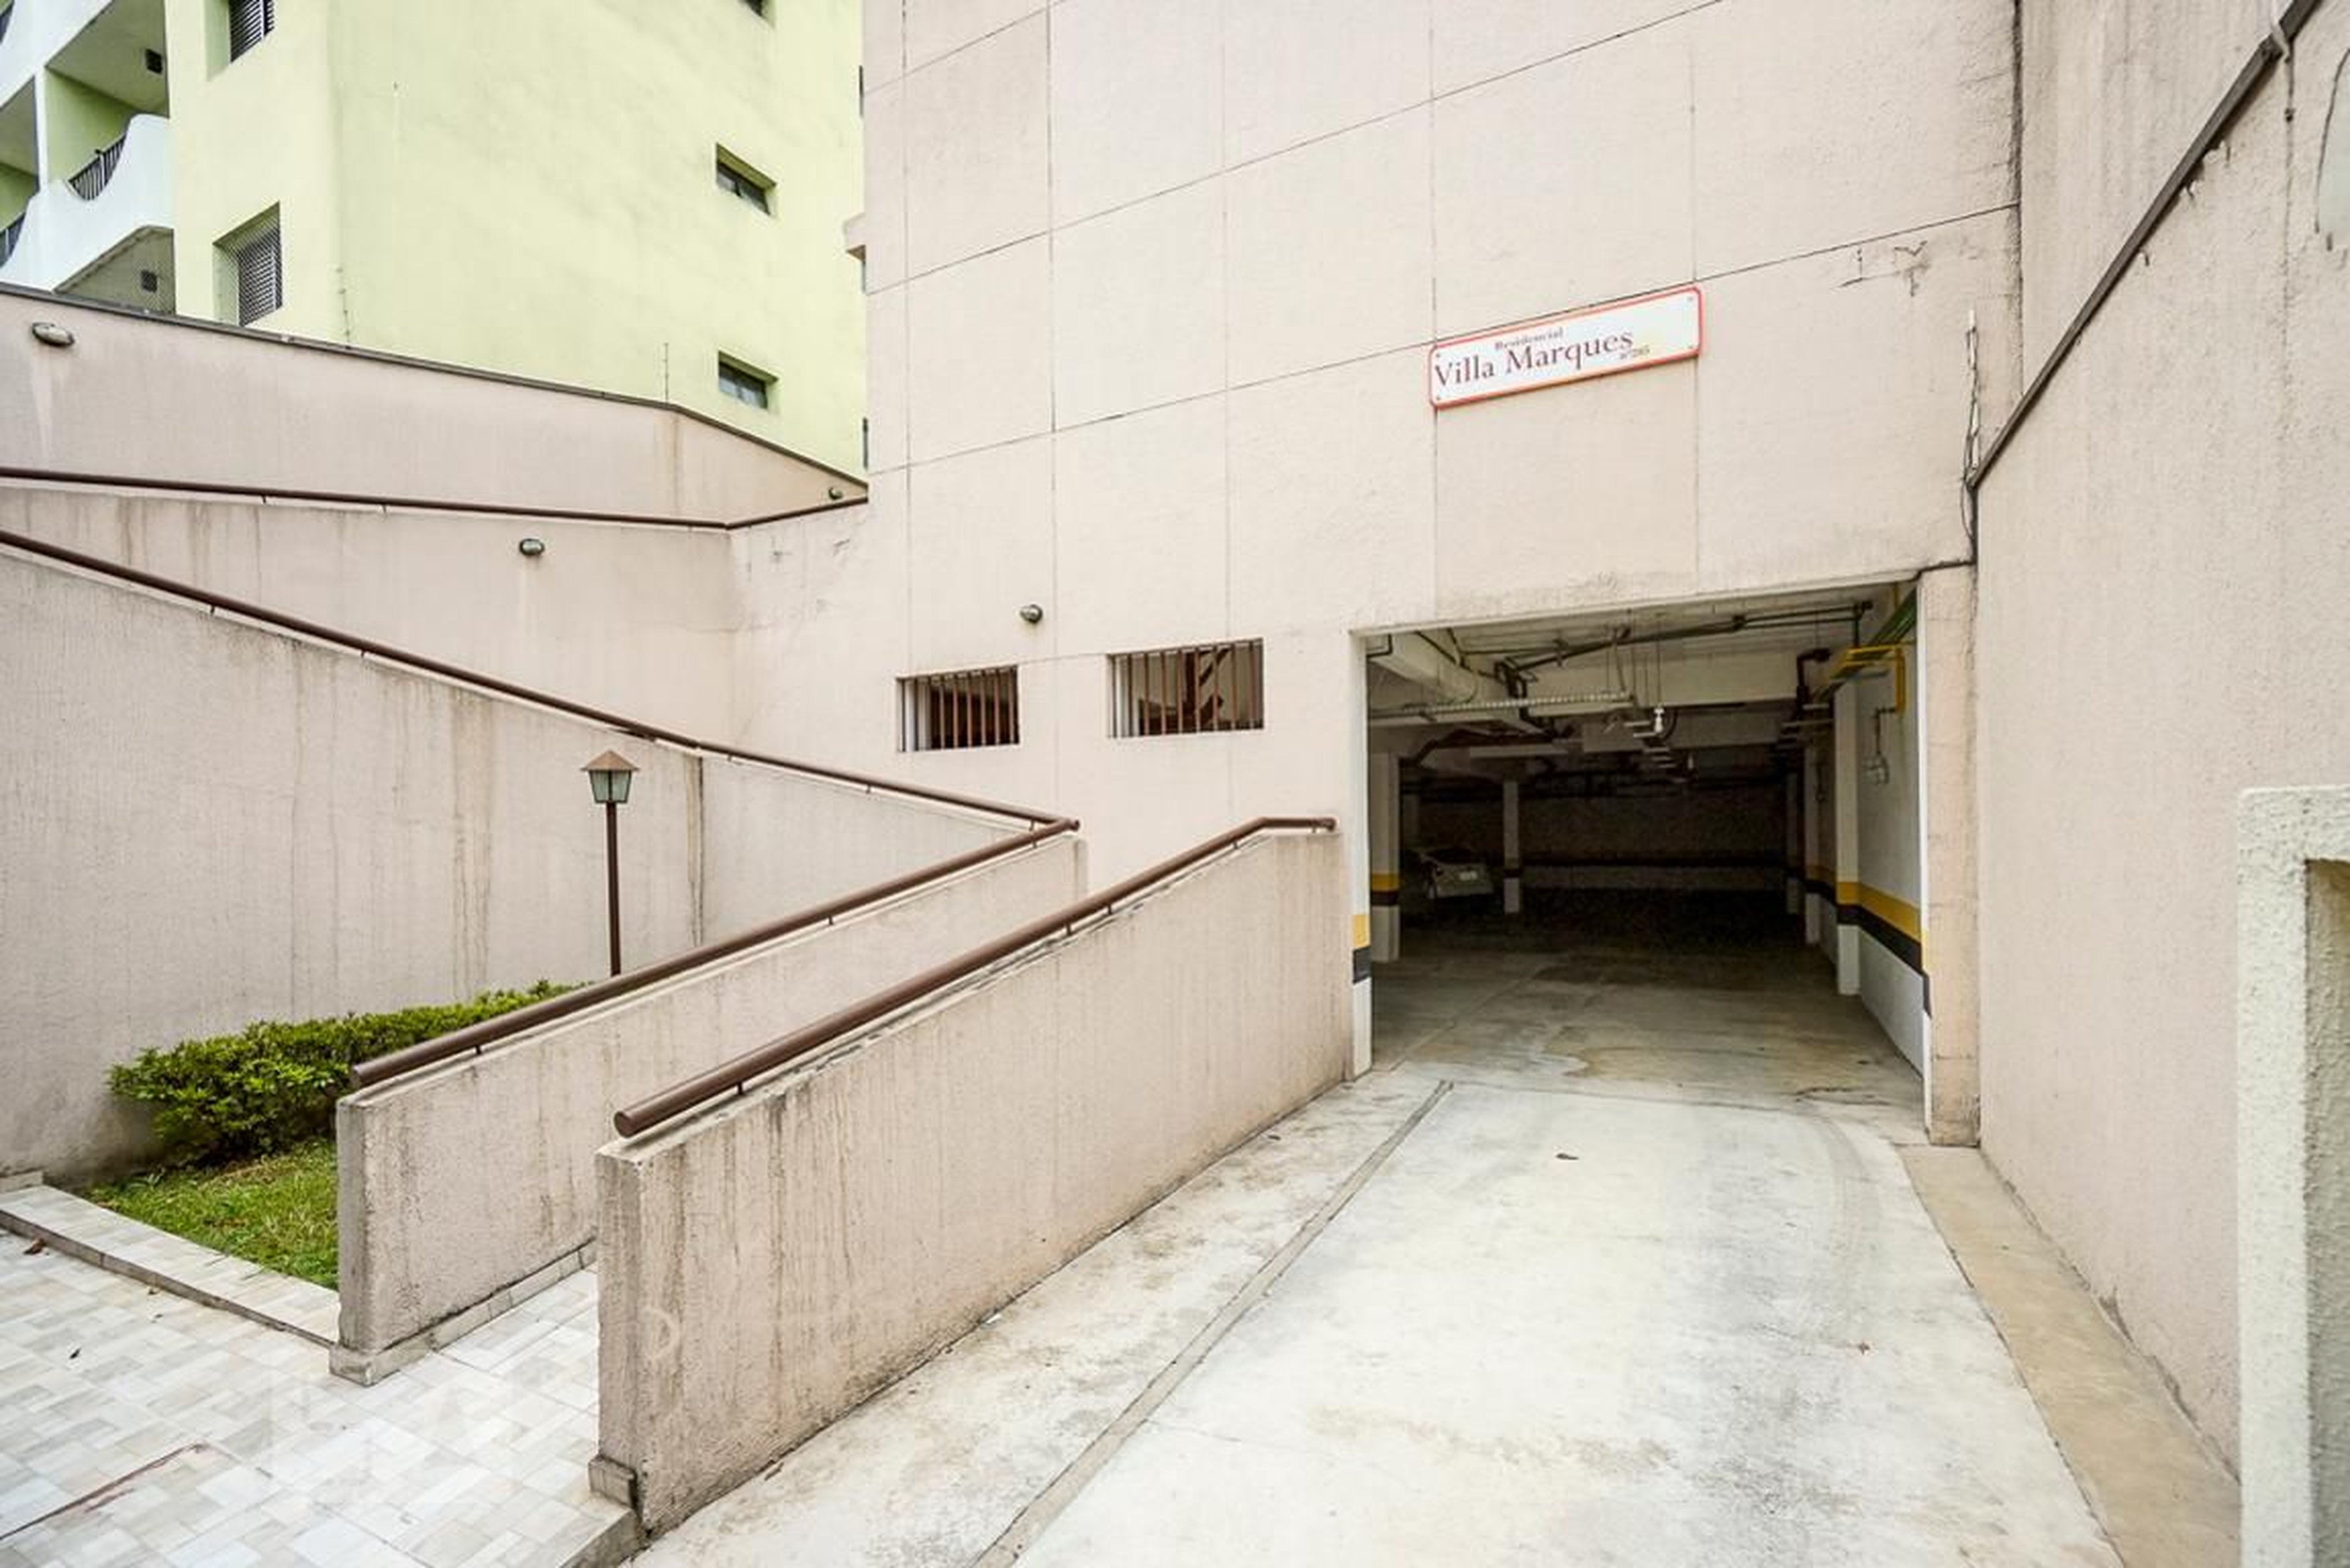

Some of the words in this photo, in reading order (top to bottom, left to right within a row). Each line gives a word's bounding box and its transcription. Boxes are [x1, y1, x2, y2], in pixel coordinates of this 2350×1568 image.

[1434, 356, 1495, 387] Villa
[1506, 331, 1634, 370] Marques
[1494, 327, 1564, 351] Residencial
